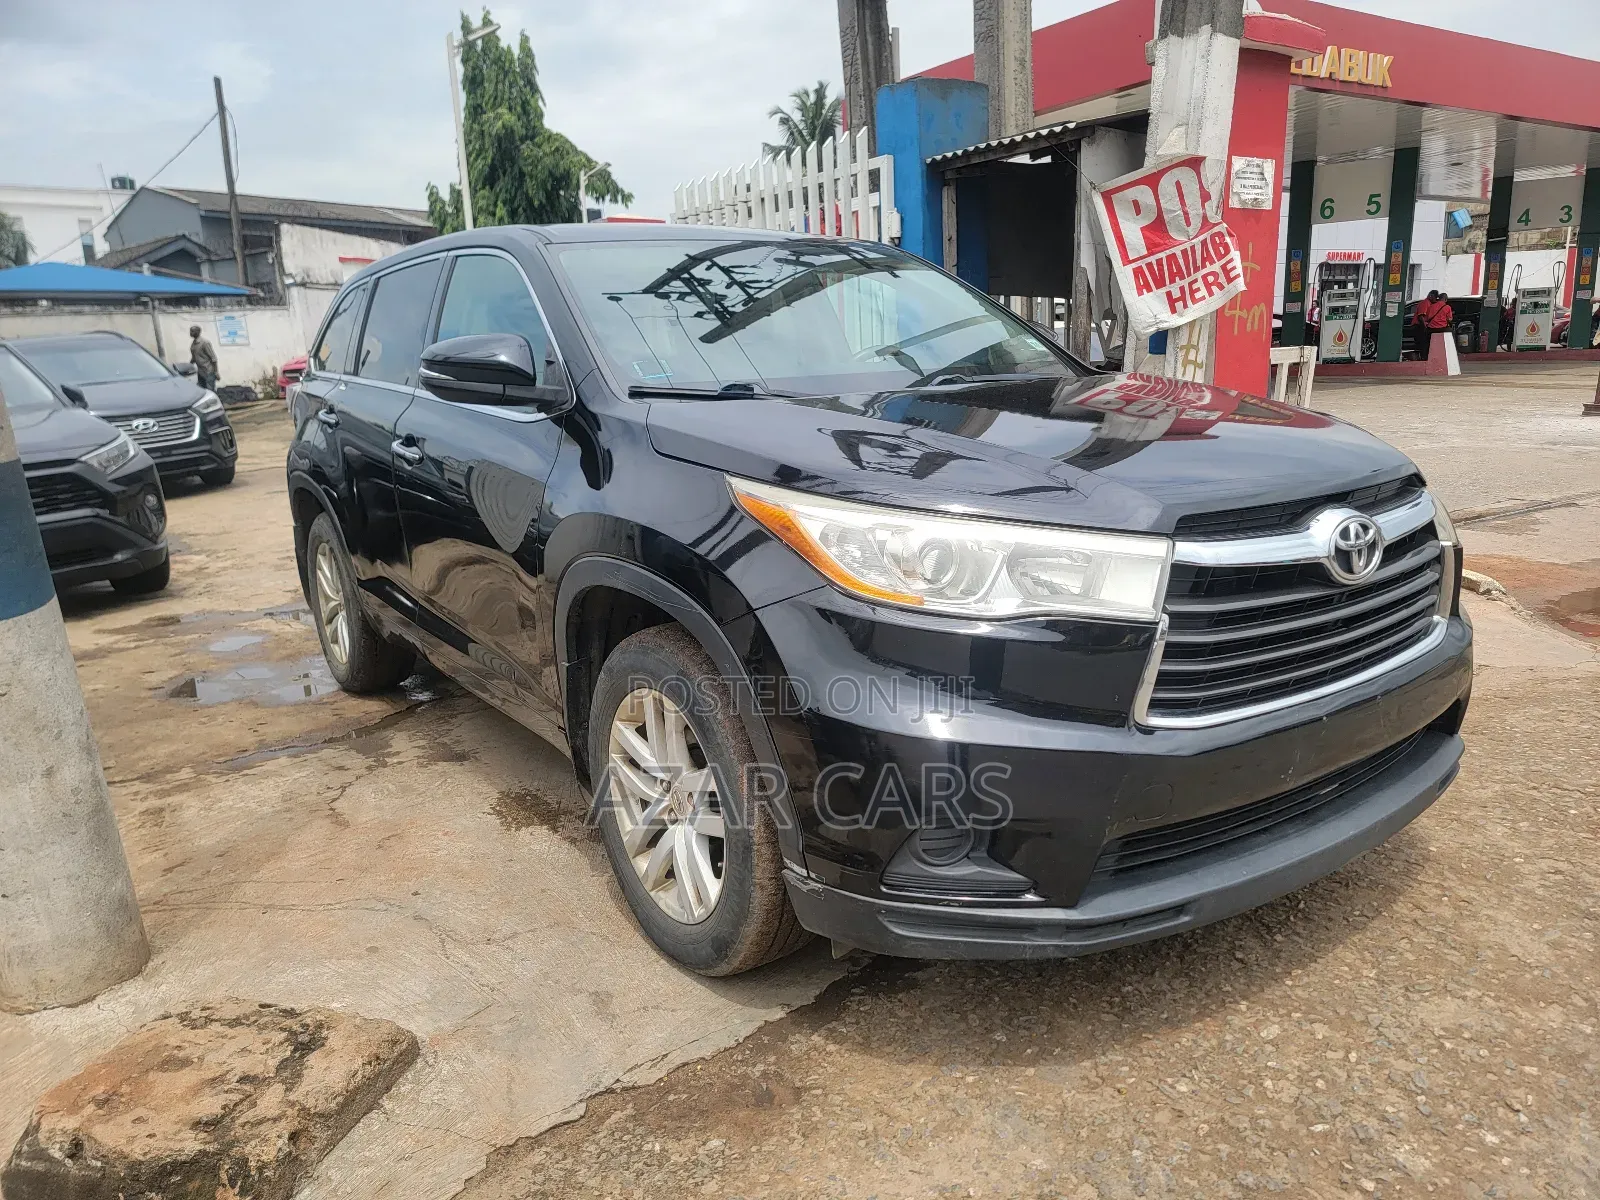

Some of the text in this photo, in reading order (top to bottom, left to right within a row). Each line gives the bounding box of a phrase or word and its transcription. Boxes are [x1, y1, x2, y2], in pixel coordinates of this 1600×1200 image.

[1320, 193, 1381, 220] 6 5
[1517, 205, 1573, 226] 4 3
[1132, 231, 1232, 297] AVAILAB
[1326, 252, 1365, 261] SUPERMART
[1165, 257, 1241, 315] HERE
